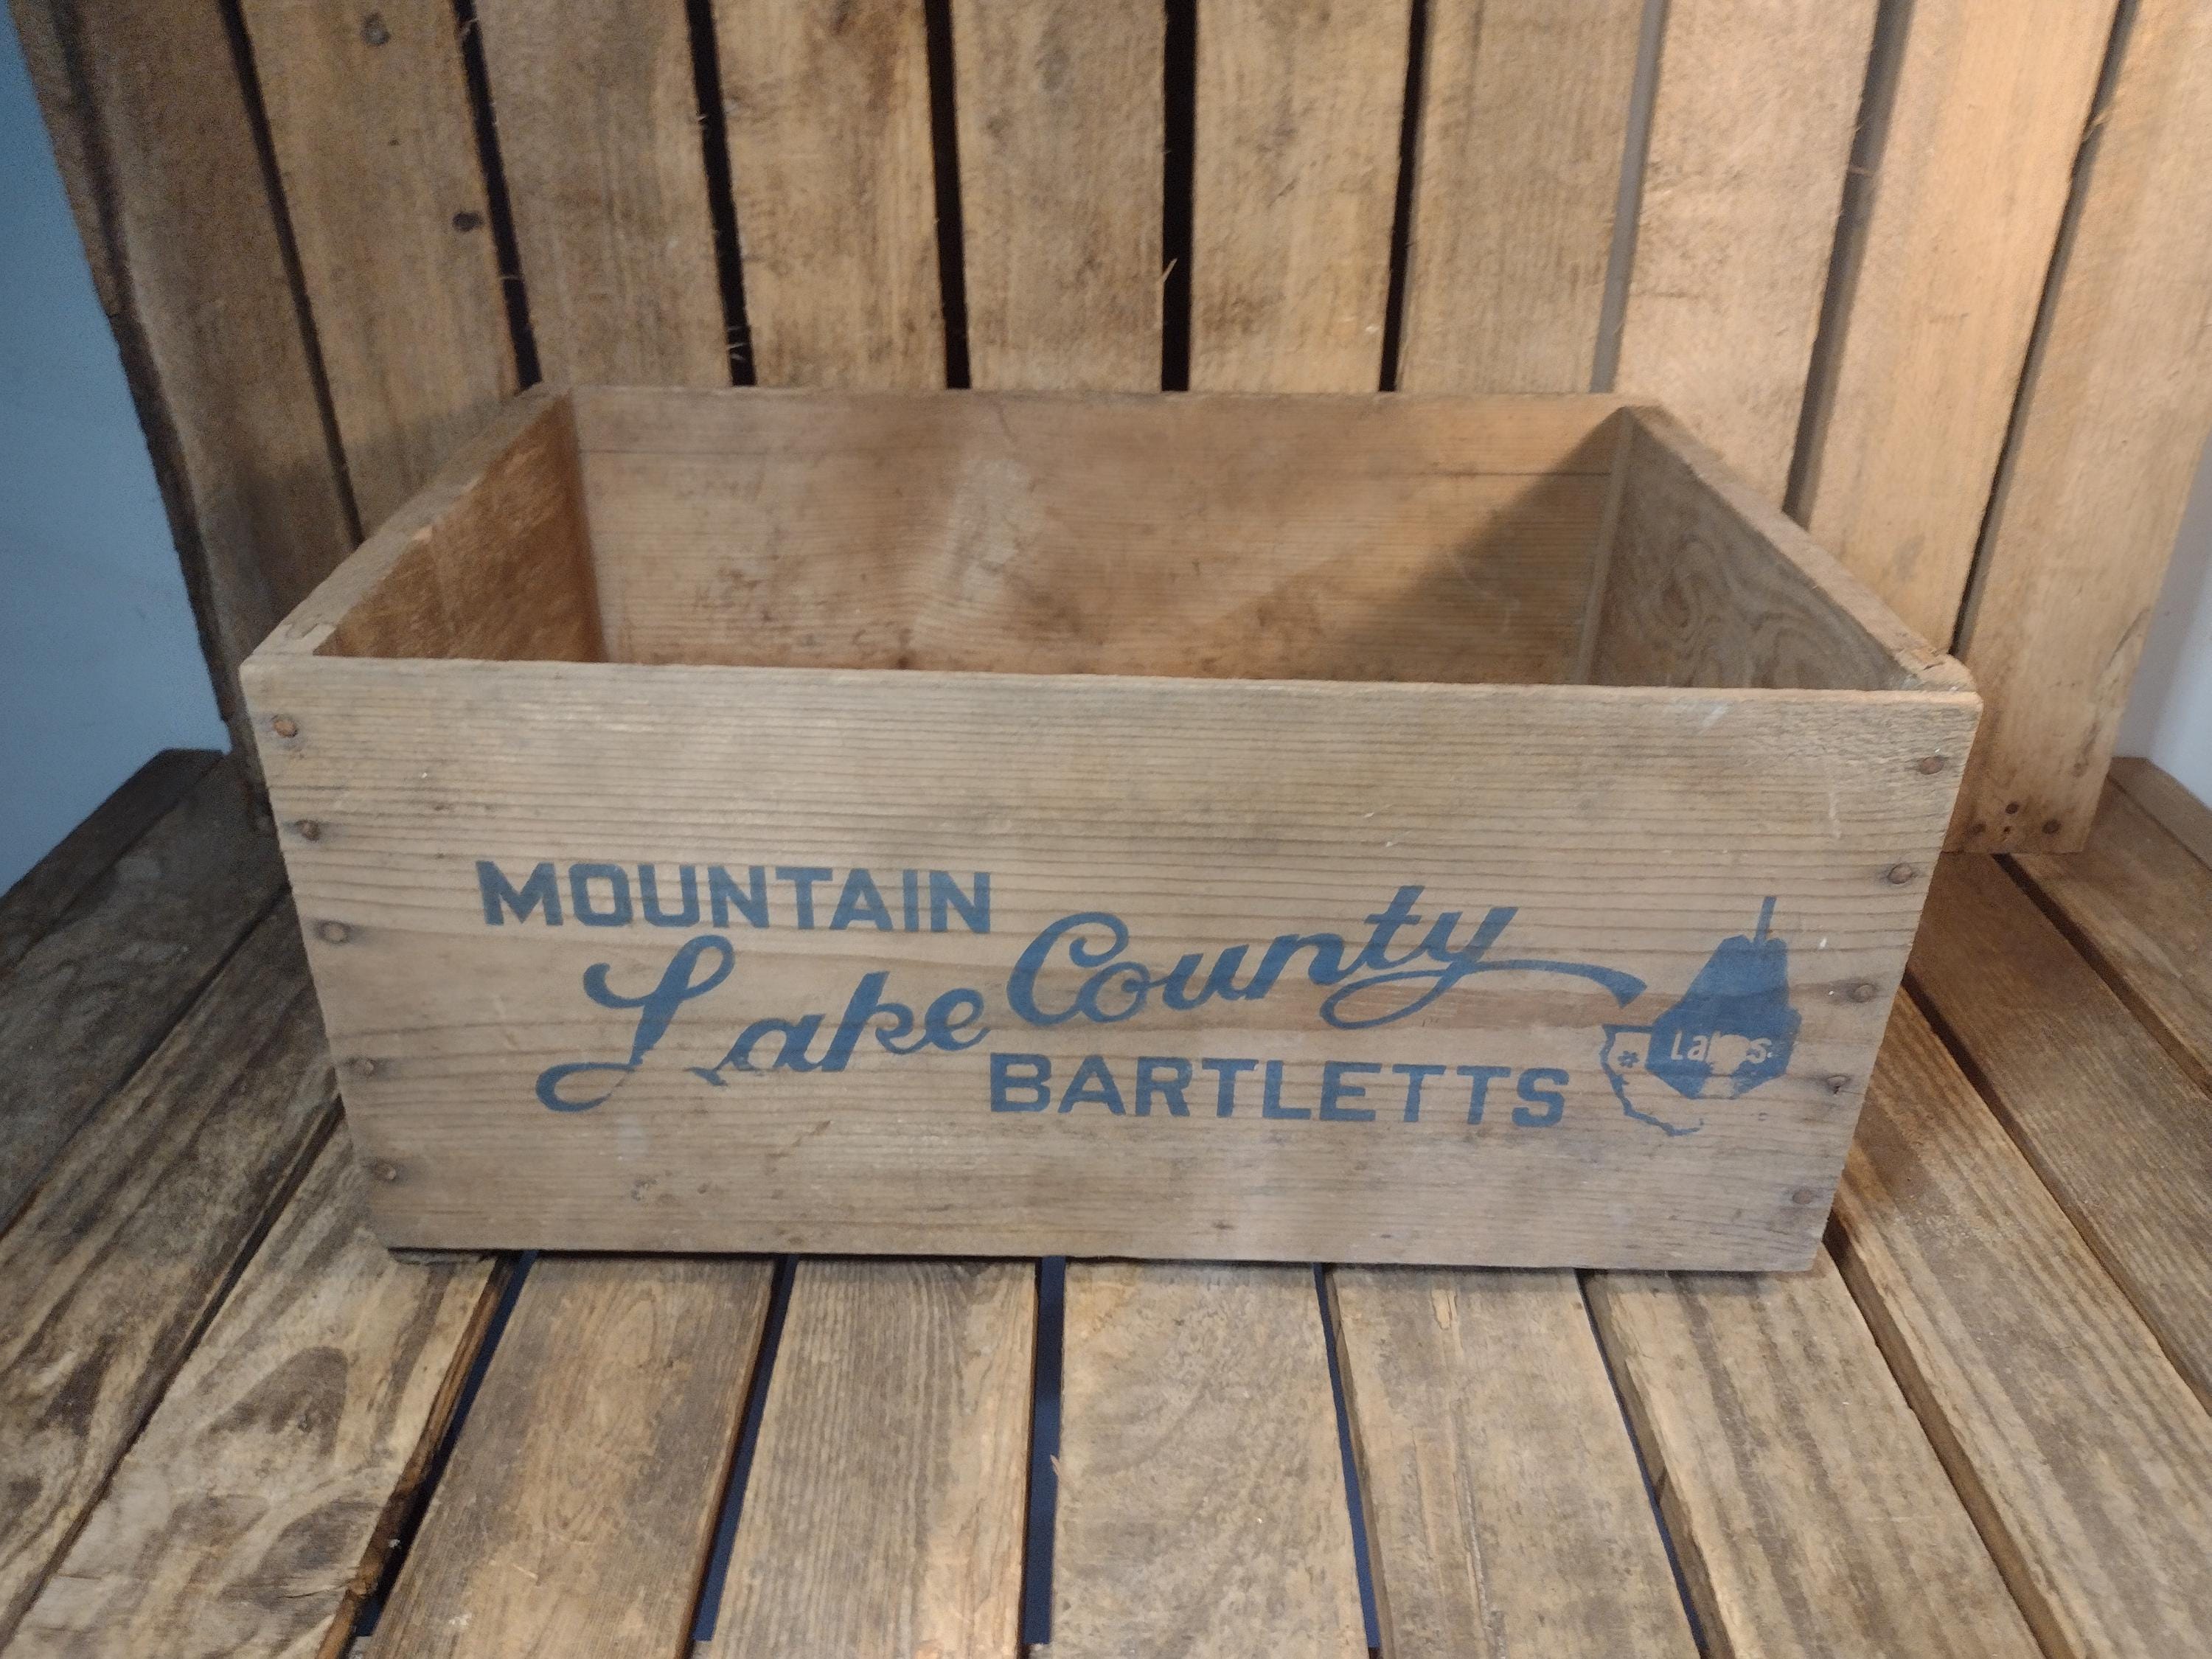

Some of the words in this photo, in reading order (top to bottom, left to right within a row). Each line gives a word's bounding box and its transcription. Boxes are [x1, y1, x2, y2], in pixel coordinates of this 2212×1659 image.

[476, 860, 992, 934] MOUNTAIN
[535, 933, 991, 1112] Lake
[1006, 885, 1647, 1029] County
[990, 1052, 1571, 1128] BARTLETTS
